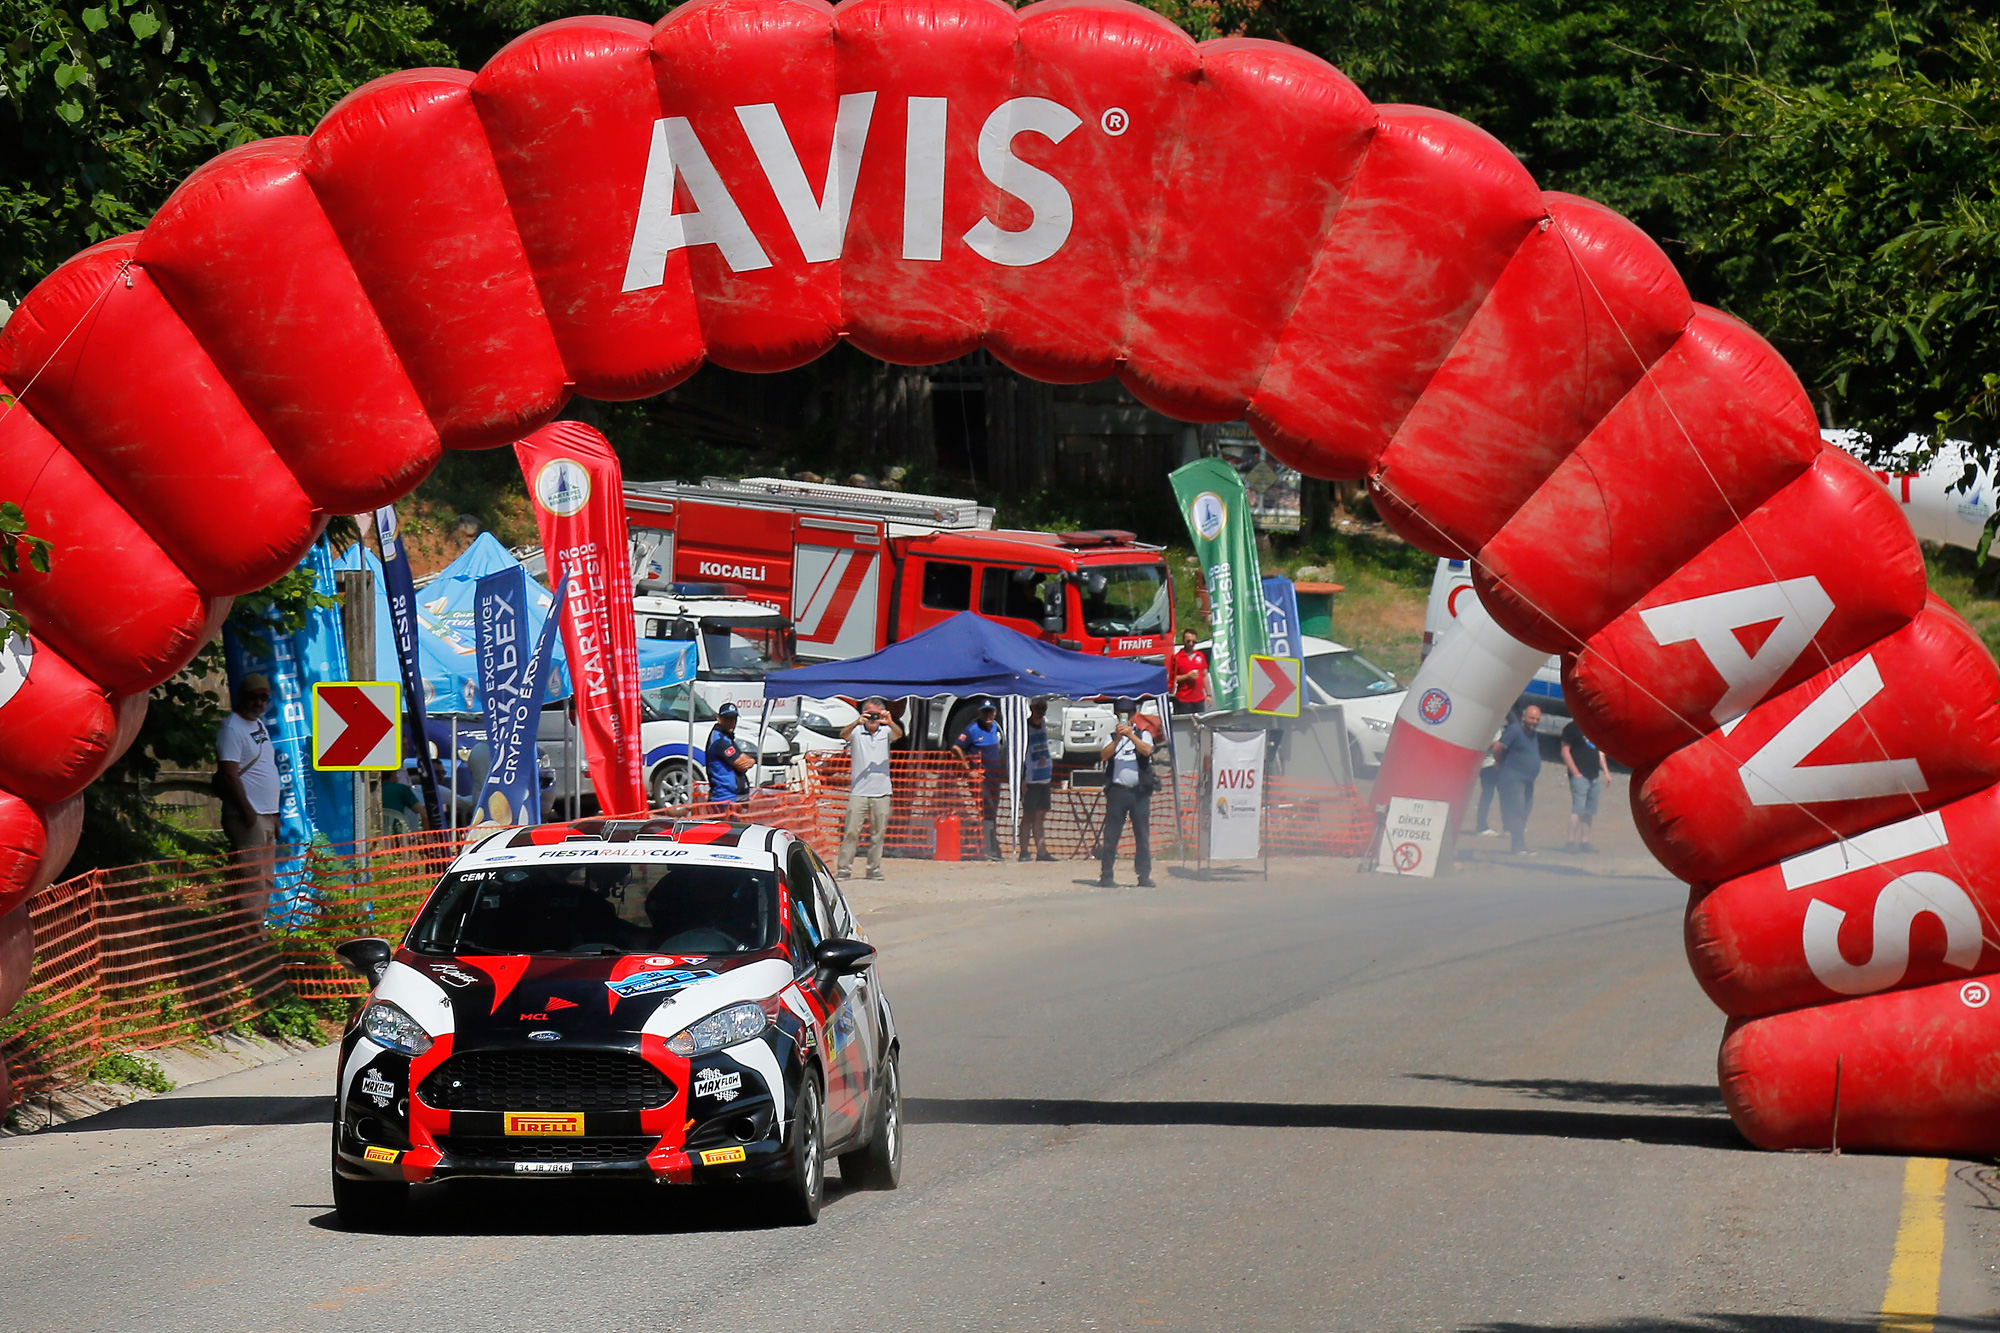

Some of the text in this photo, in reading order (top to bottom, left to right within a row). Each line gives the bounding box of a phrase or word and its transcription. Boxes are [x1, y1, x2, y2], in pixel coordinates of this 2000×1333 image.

[621, 91, 1083, 293] AVIS
[699, 562, 766, 581] KOCAELİ
[560, 558, 609, 697] KARTEPE
[503, 705, 529, 785] CRYPTO
[277, 752, 300, 819] Kartepe
[1217, 769, 1256, 790] AVIS
[1639, 575, 1984, 996] AVIS
[459, 871, 497, 882] CEM Y.
[520, 1013, 549, 1021] MCL
[511, 1117, 577, 1132] PIRELLI
[366, 1149, 395, 1161] PIRELLI
[704, 1149, 743, 1163] PIRELLI
[518, 1164, 529, 1172] 34
